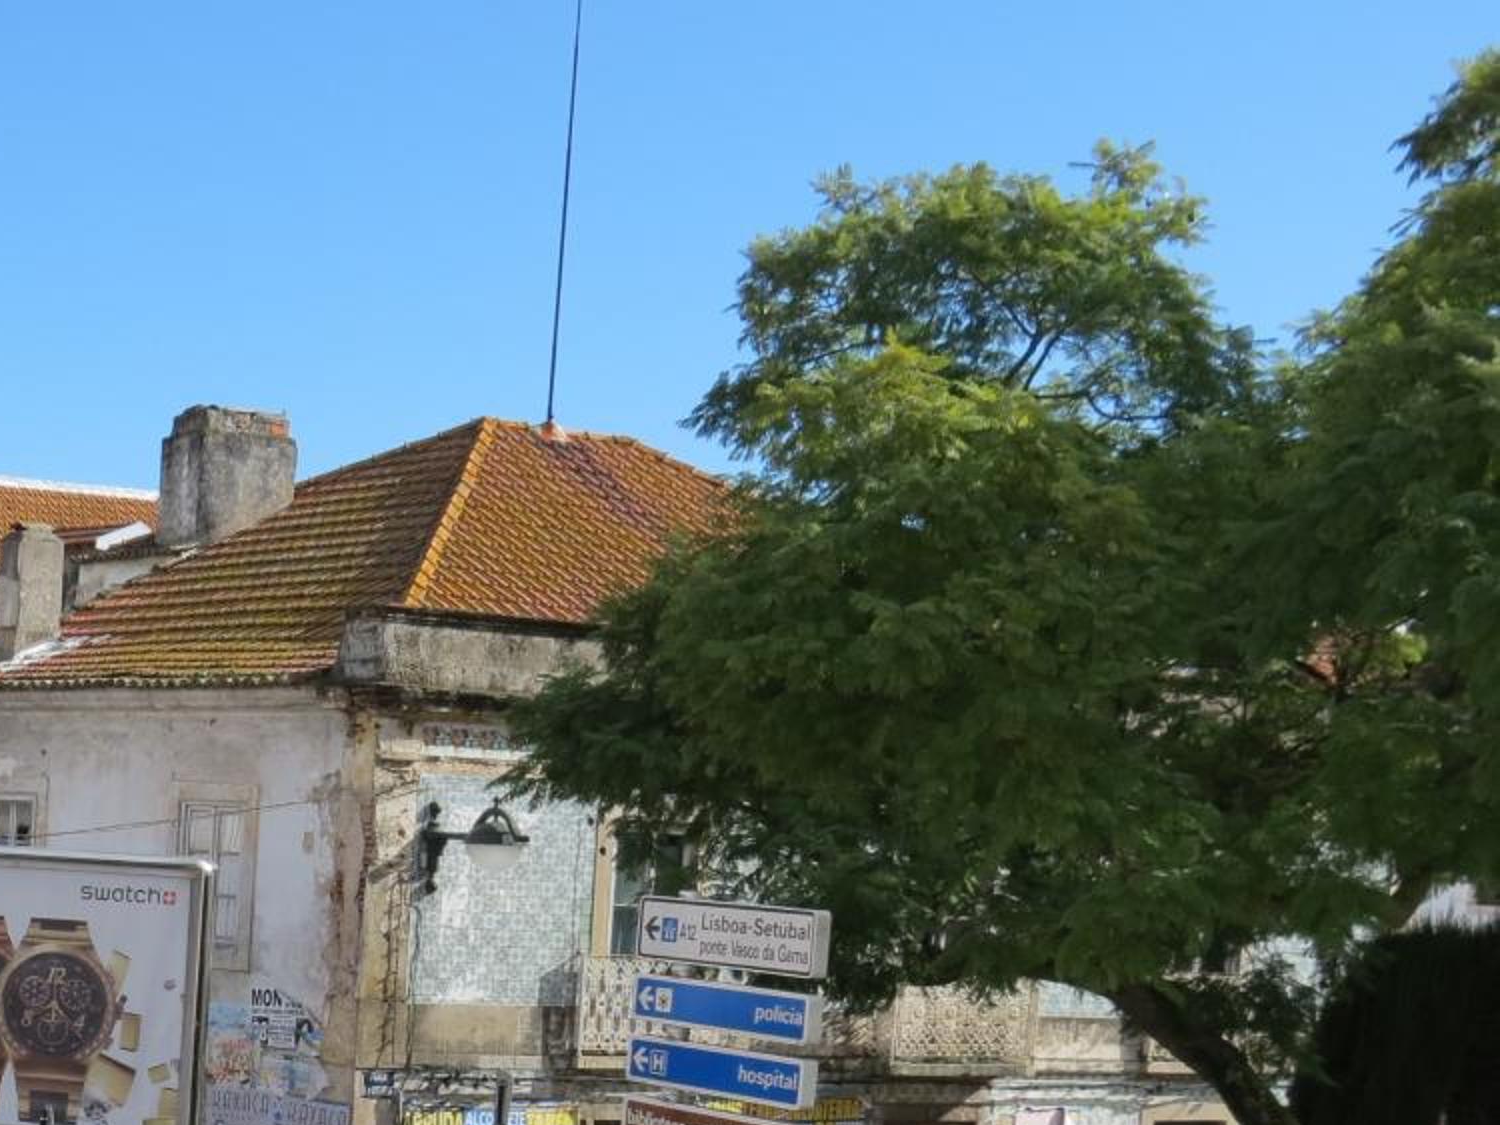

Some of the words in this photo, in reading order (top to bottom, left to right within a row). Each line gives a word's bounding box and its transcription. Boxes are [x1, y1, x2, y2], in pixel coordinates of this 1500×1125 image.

[80, 885, 161, 904] swatch
[679, 923, 697, 941] A12
[700, 912, 811, 941] Lisboa-Setúbal
[699, 940, 728, 957] ponte
[731, 942, 760, 960] Vasco
[762, 946, 775, 961] da
[653, 1056, 663, 1070] H
[737, 1064, 798, 1091] hospital
